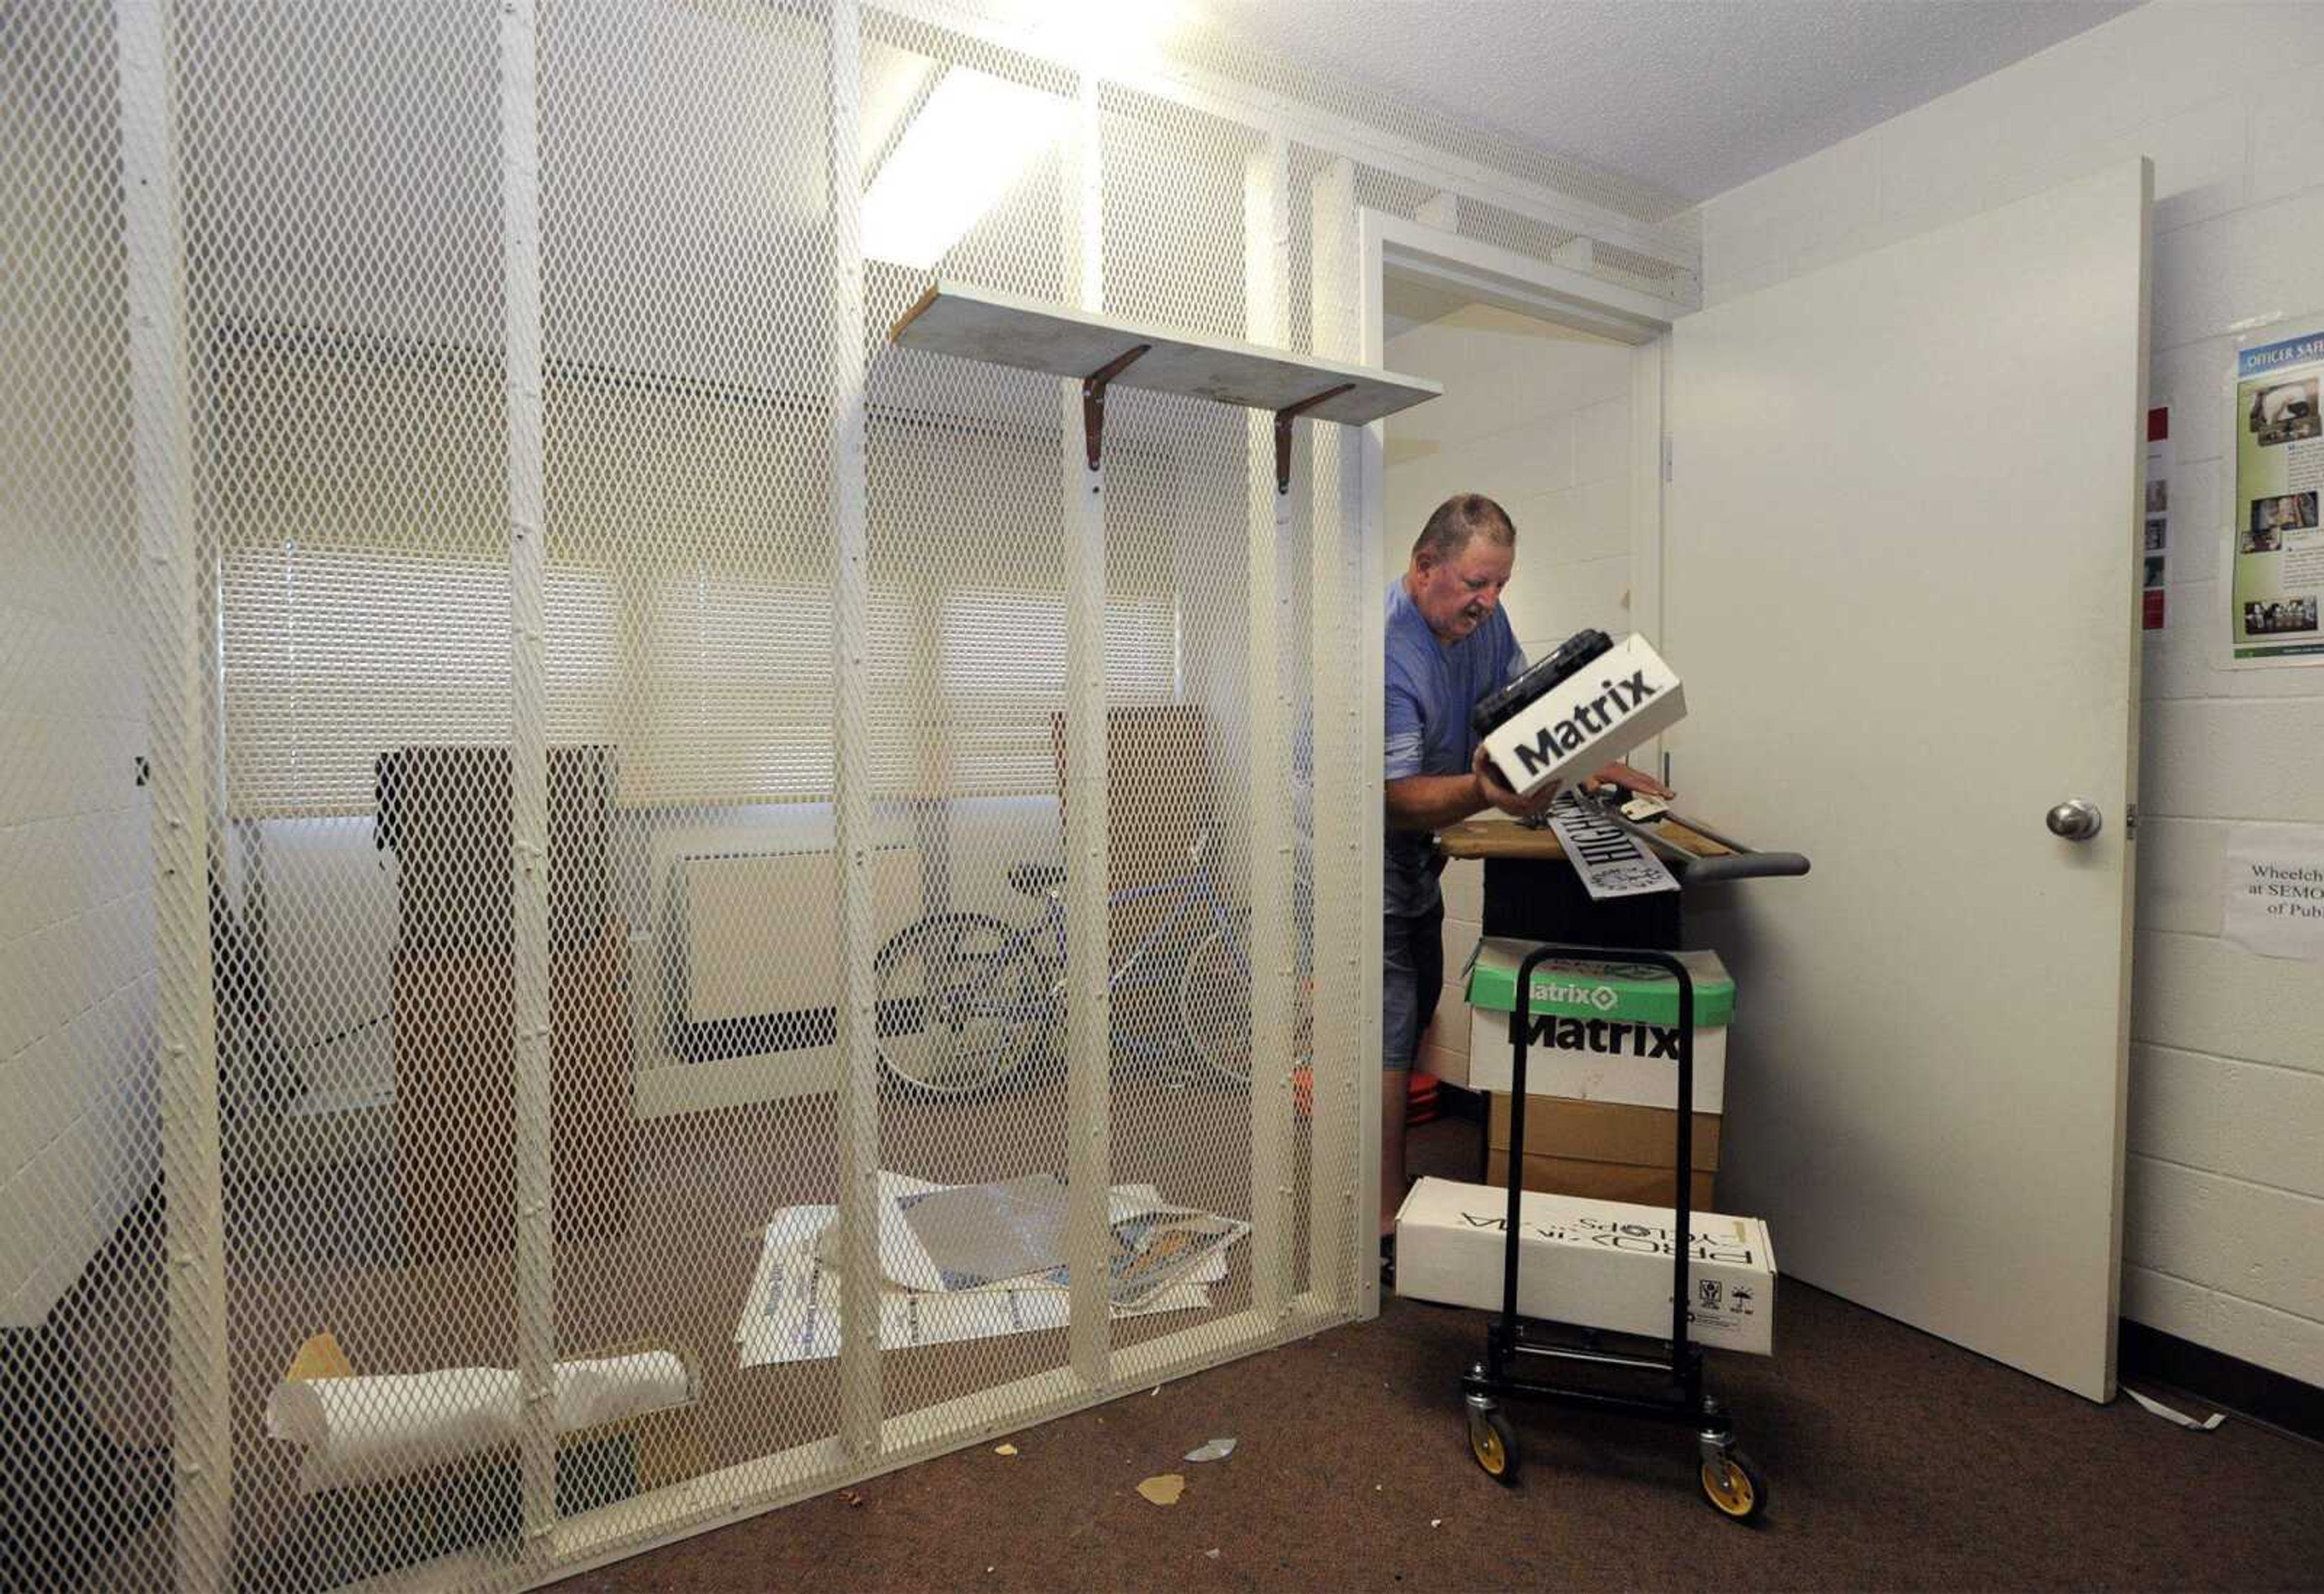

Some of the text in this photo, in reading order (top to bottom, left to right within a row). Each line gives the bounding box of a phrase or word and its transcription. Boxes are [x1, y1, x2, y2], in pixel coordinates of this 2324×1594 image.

[1514, 670, 1656, 776] Matrix
[2267, 903, 2283, 915] of
[1529, 982, 1590, 1004] atrix
